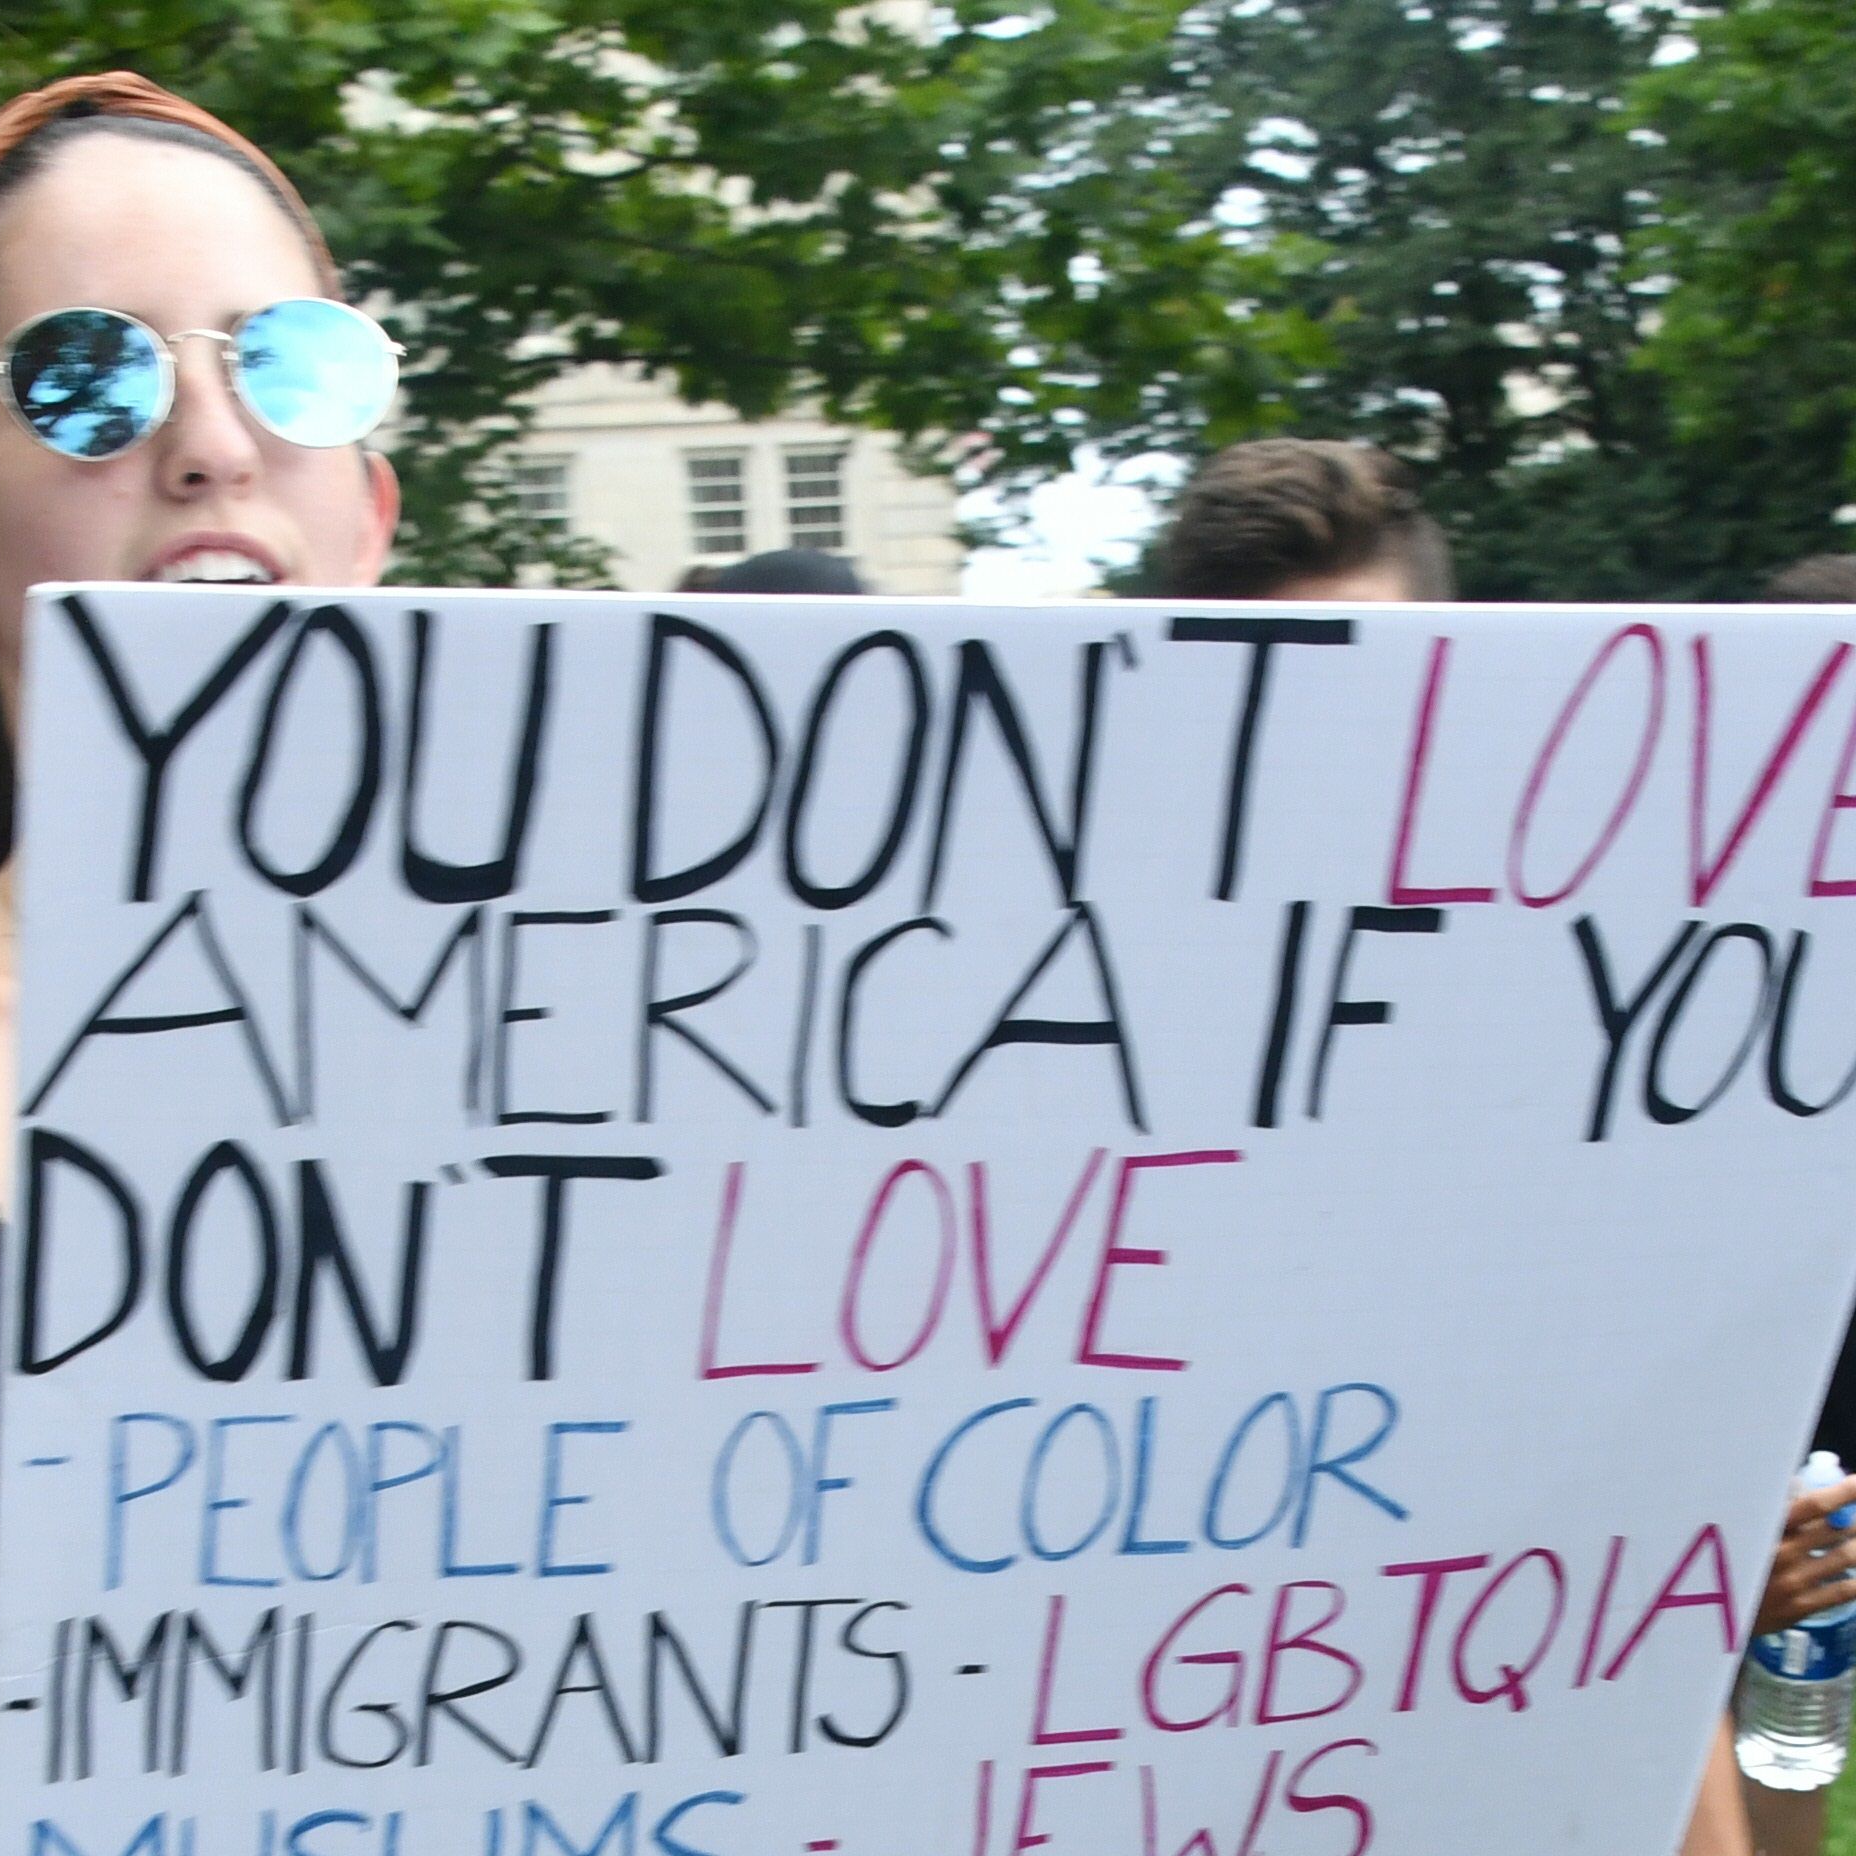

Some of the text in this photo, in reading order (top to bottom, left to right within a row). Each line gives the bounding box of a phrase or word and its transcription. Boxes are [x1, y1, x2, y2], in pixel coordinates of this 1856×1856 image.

[53, 594, 559, 903] YOU
[630, 612, 1357, 916] DON'T
[22, 889, 1149, 1134] AMERICA
[1251, 899, 1446, 1128] IF
[16, 1126, 1244, 1385] DON'T LOVE
[709, 1398, 900, 1567] OF
[914, 1382, 1410, 1574] COLOR
